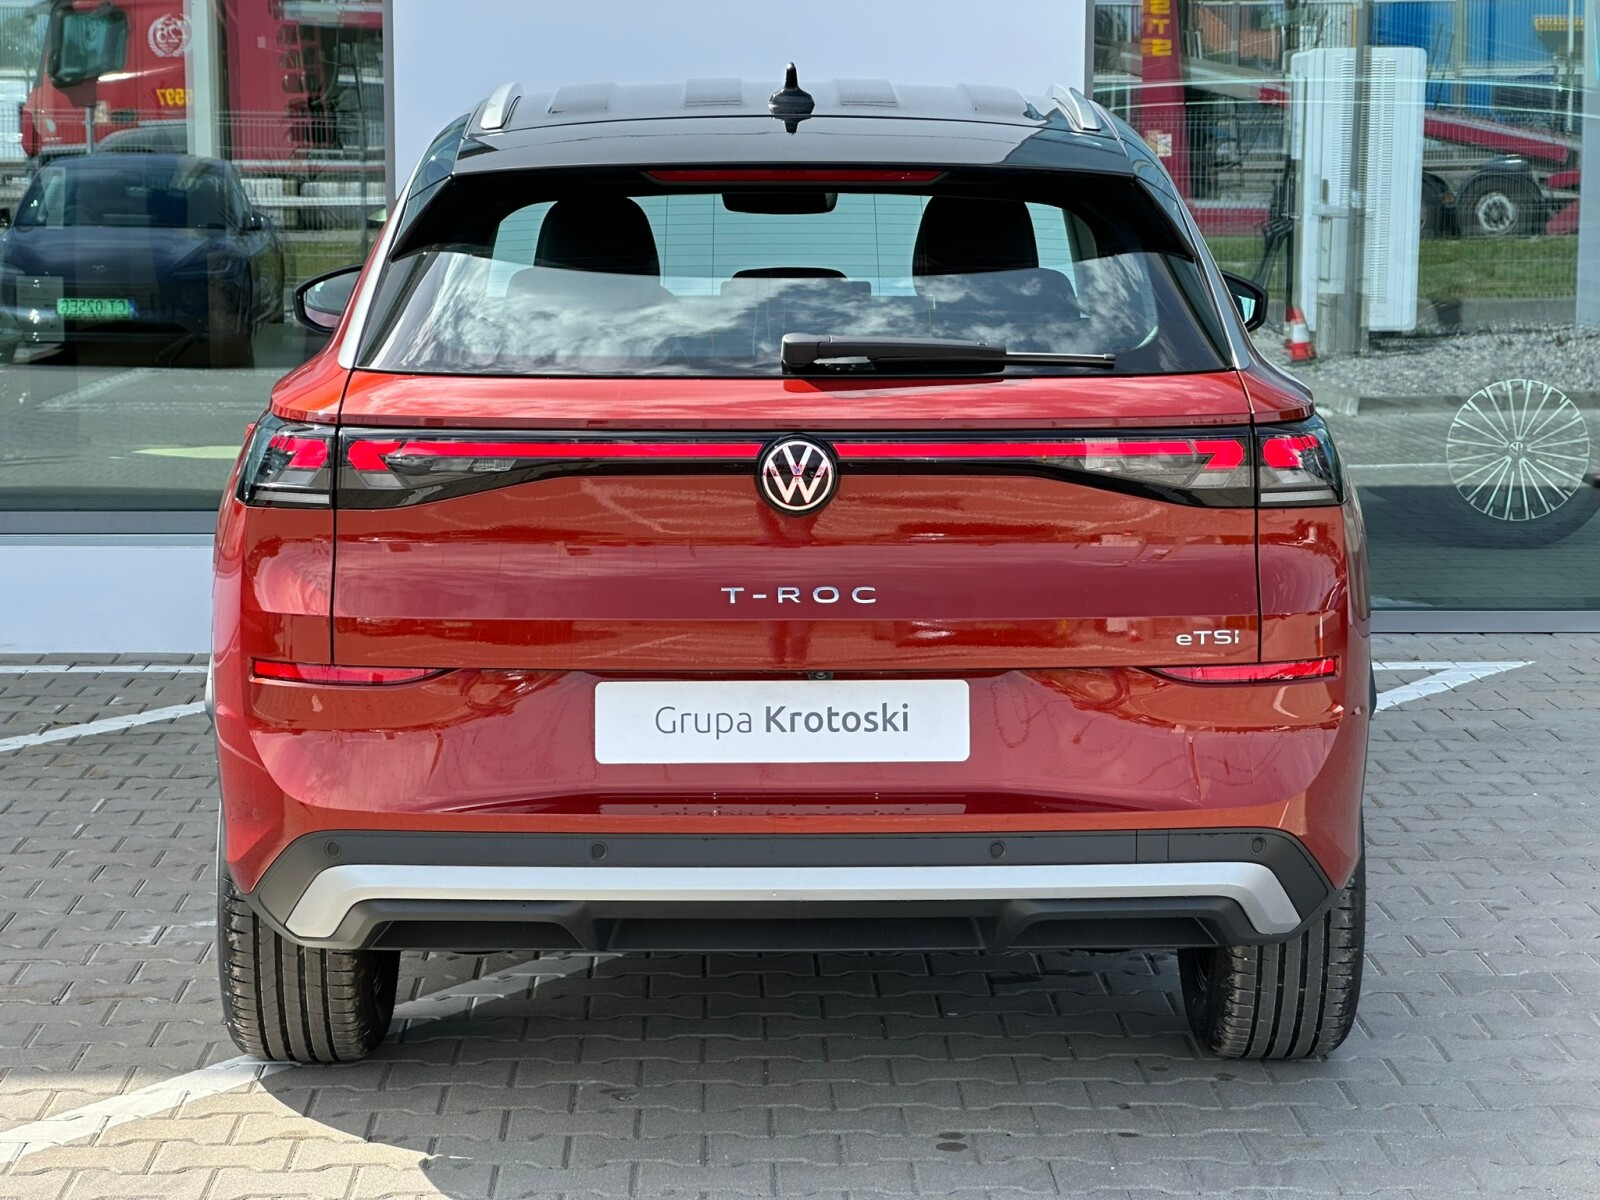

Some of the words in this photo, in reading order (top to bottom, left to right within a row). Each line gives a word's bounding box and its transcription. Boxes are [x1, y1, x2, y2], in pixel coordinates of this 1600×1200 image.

[720, 586, 877, 604] T-ROC
[655, 706, 752, 740] Grupa
[766, 702, 909, 733] Krotoski
